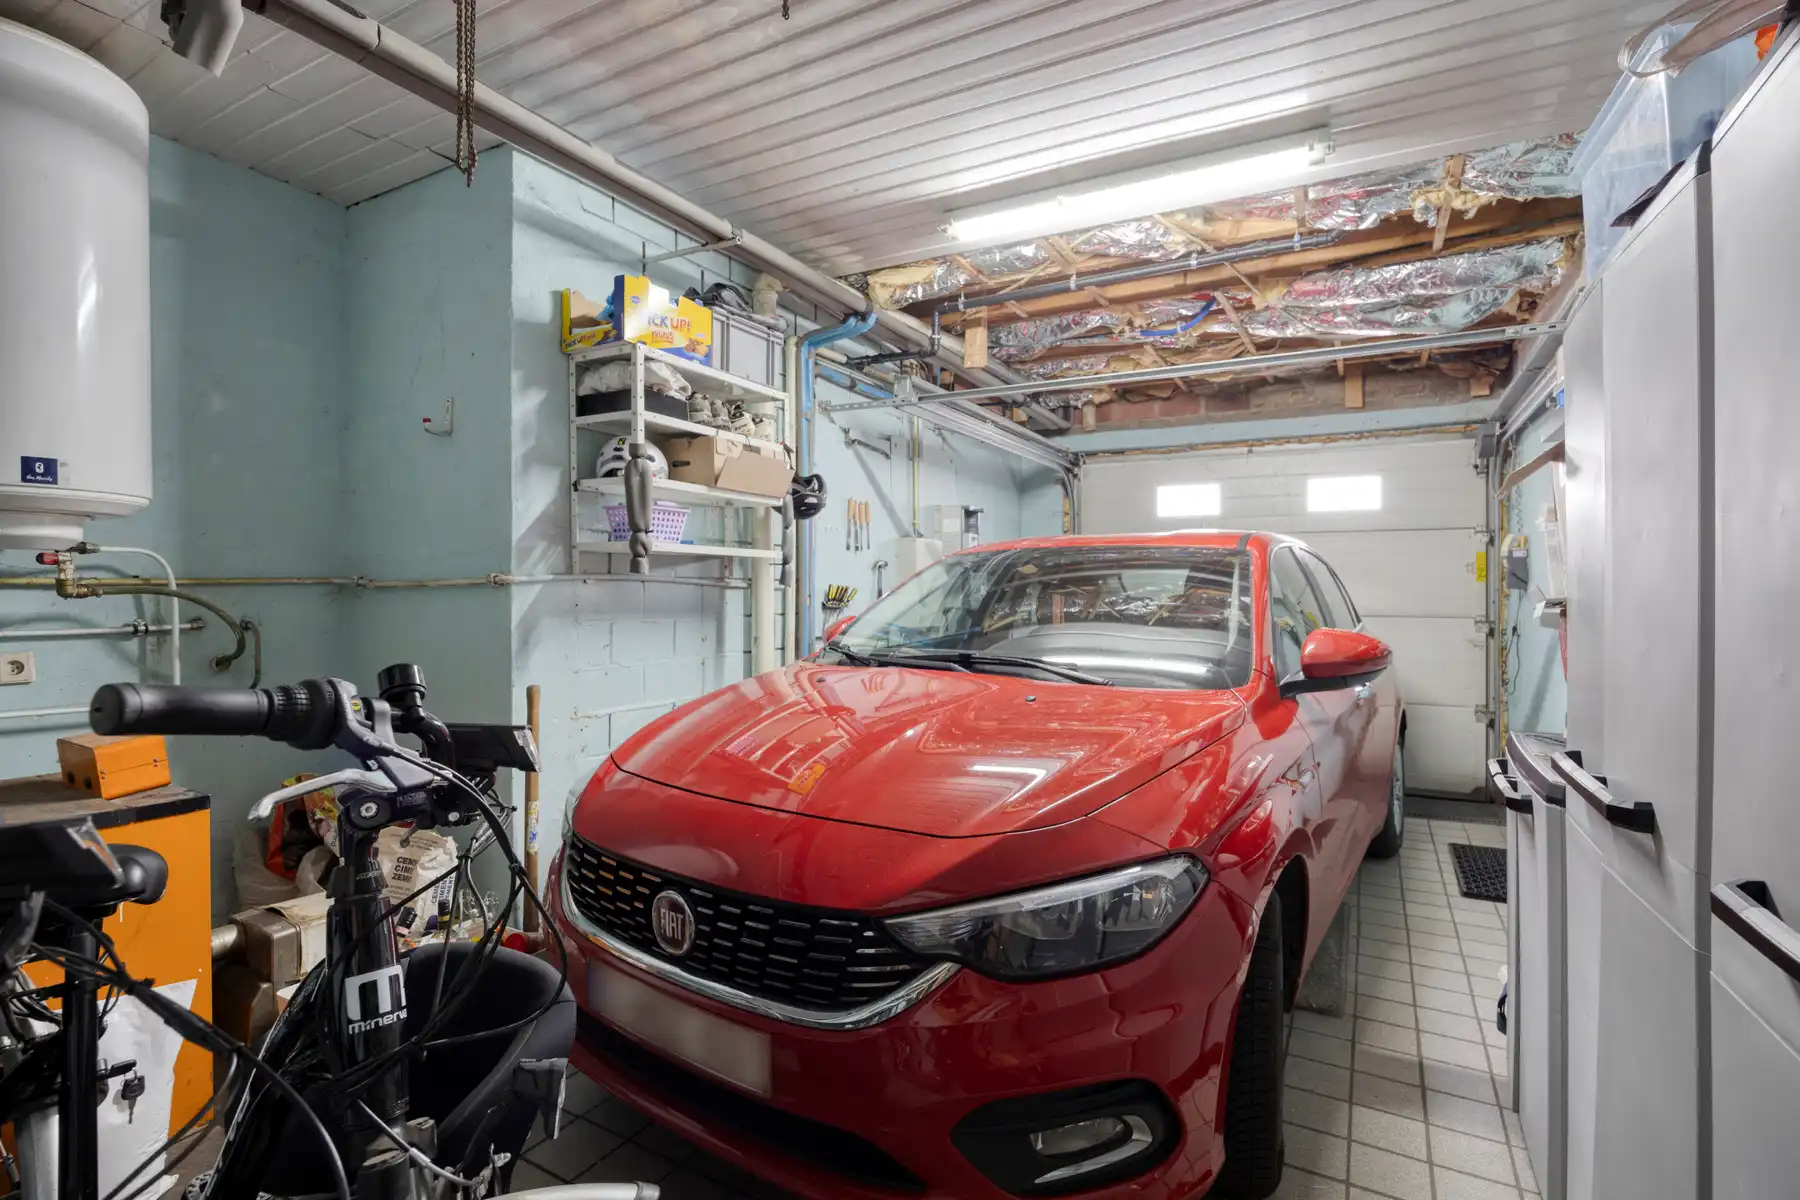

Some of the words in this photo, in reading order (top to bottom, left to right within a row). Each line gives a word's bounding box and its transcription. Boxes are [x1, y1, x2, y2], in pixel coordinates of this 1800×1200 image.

[647, 314, 668, 328] ICK
[396, 856, 418, 867] CEM
[660, 907, 683, 940] FIAT
